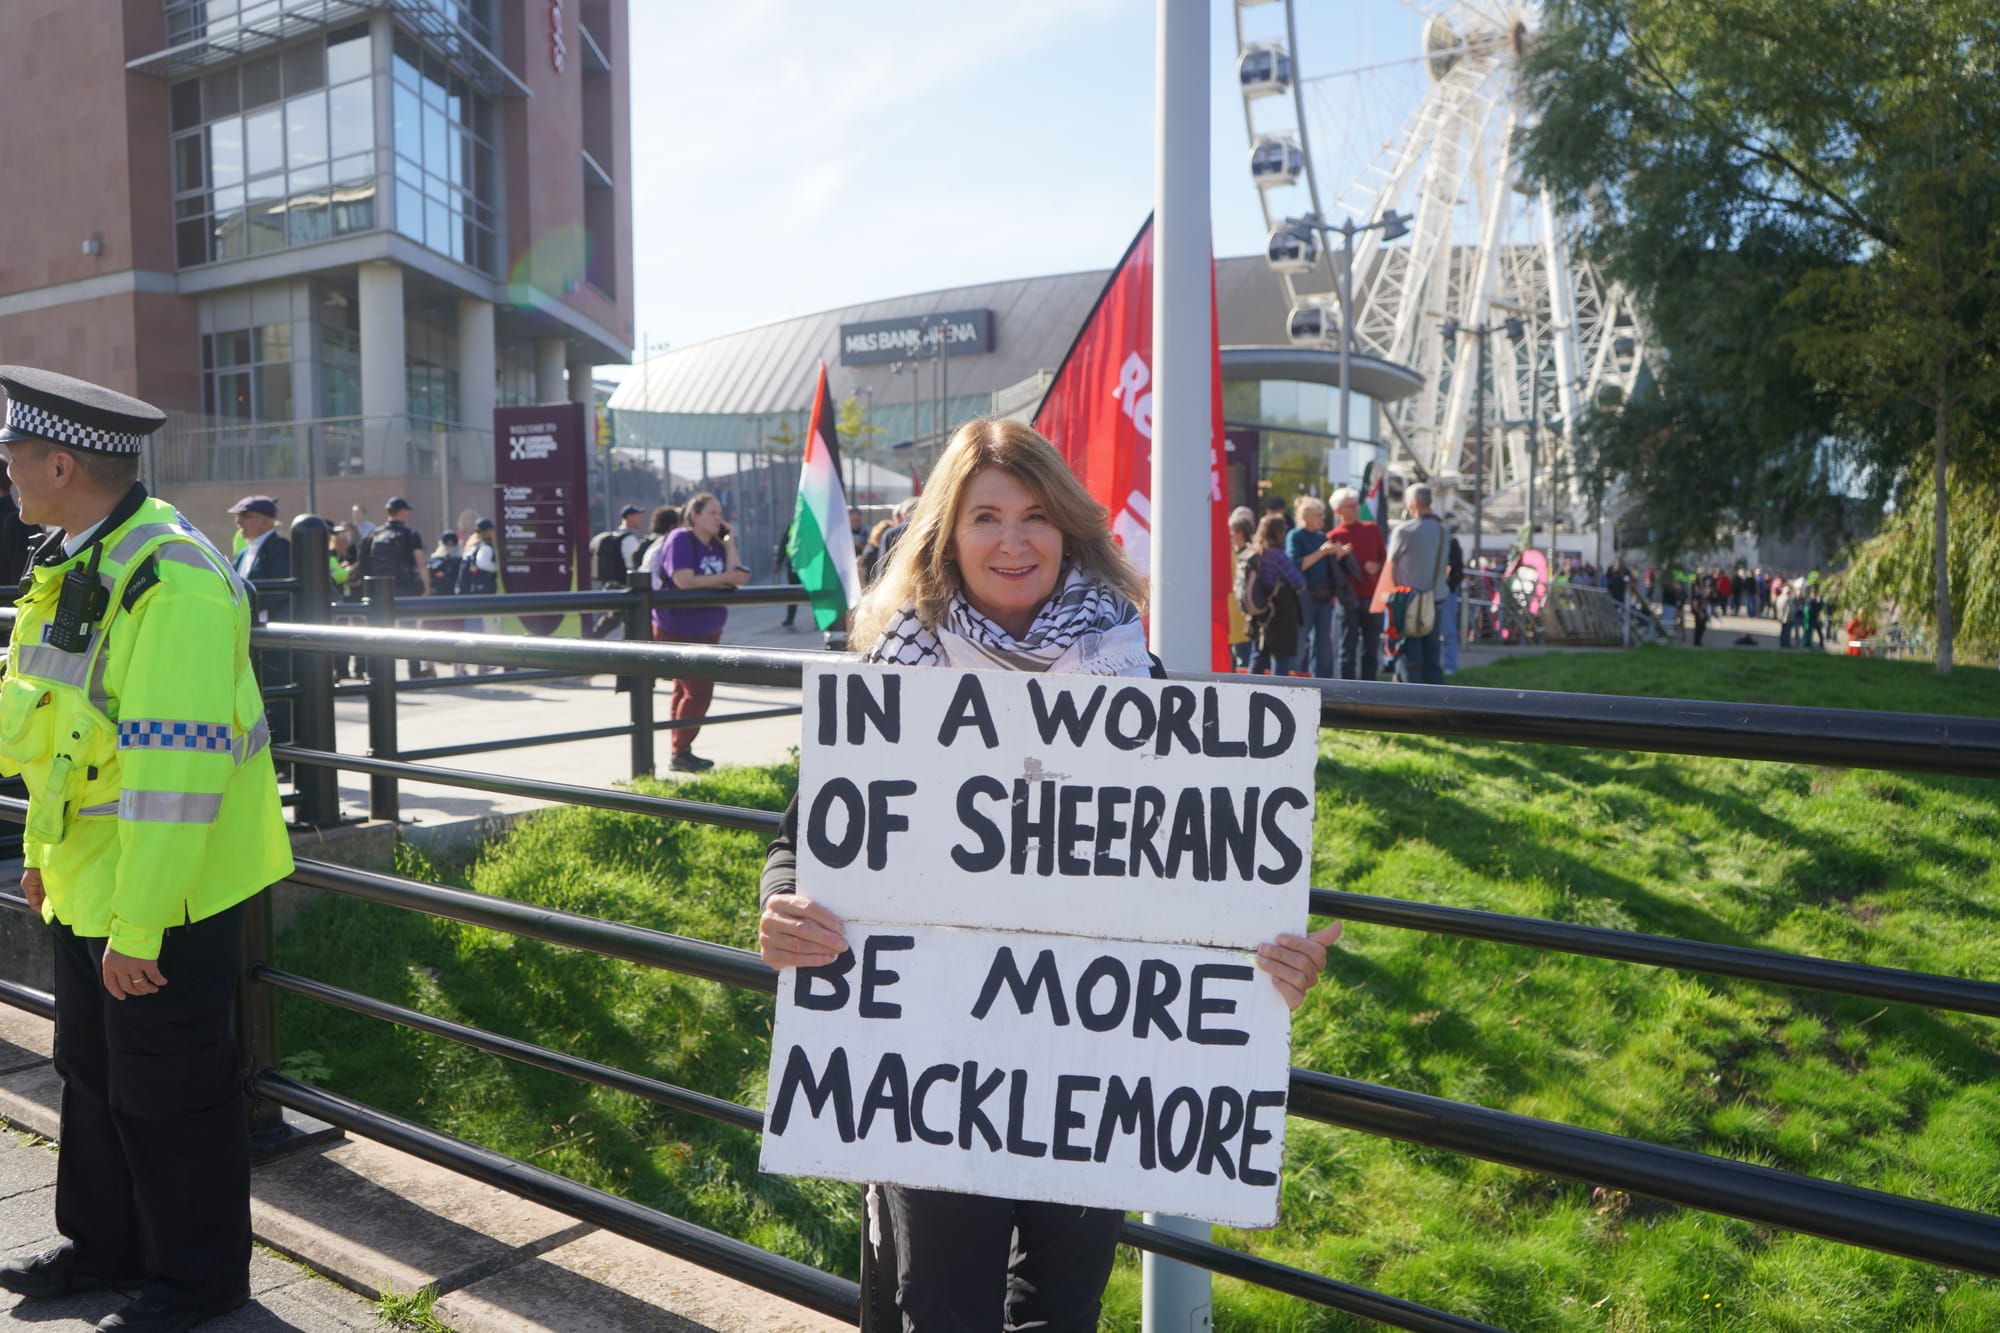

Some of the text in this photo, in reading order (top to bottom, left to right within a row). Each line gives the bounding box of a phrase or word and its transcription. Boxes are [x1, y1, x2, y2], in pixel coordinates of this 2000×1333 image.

[879, 327, 921, 350] BANK
[818, 673, 1297, 759] IN A WORLD
[806, 775, 1309, 886] OF SHEERANS
[793, 934, 1254, 1046] BE MORE
[768, 1044, 1286, 1187] MACKLEMORE
